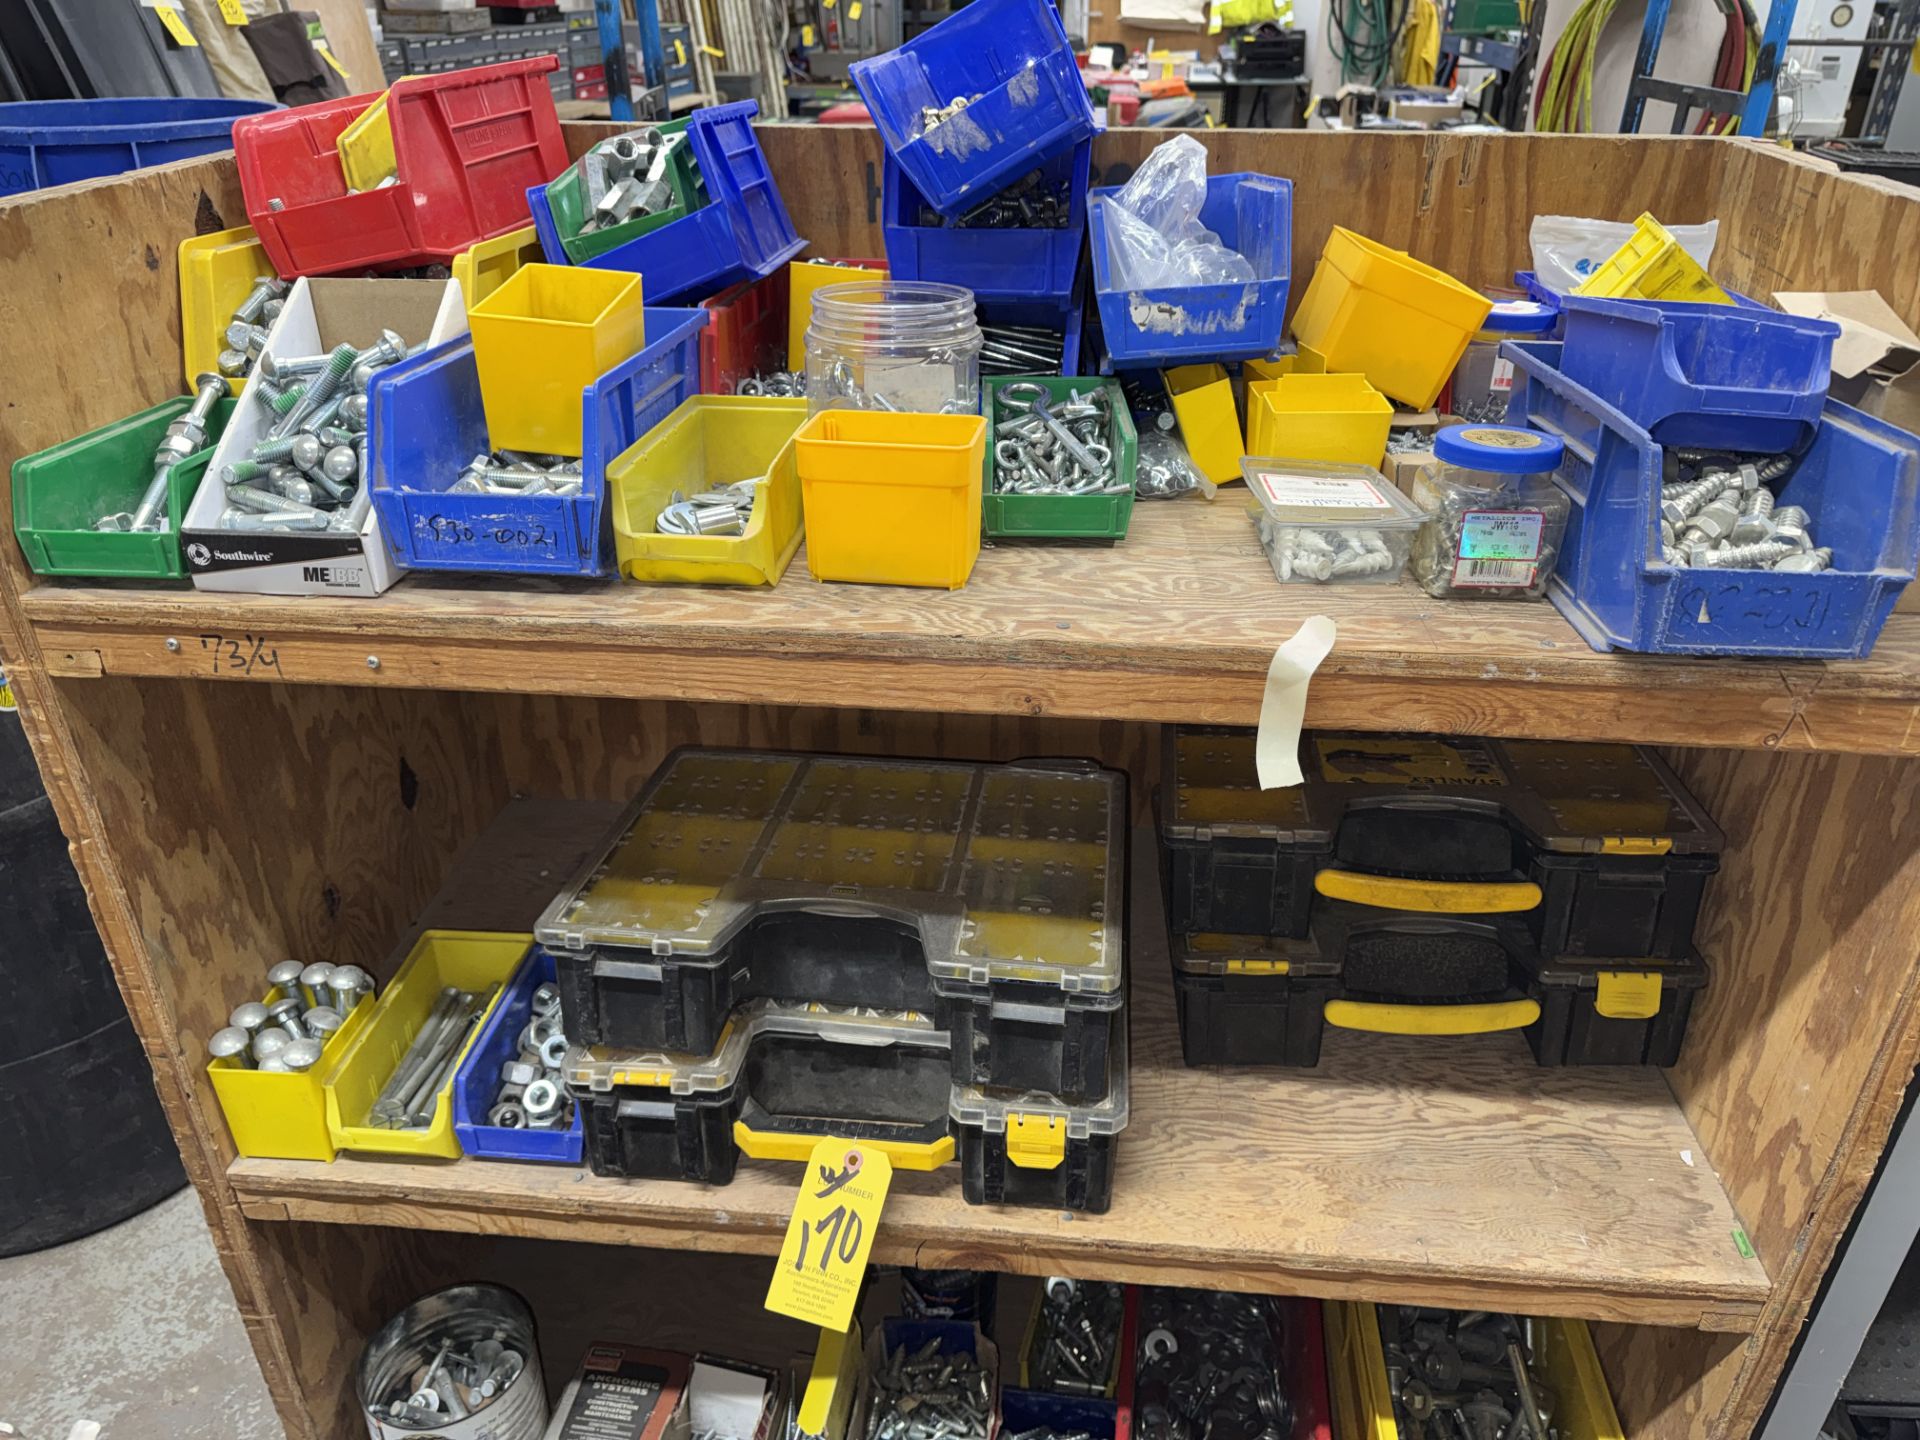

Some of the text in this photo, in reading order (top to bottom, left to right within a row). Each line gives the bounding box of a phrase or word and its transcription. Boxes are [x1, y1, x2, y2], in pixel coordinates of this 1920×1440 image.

[214, 550, 269, 562] Southwire
[1410, 776, 1502, 786] STANLEY
[795, 1204, 863, 1272] 170
[586, 1373, 660, 1391] ANCHORING
[592, 1381, 649, 1396] SYSTEMS
